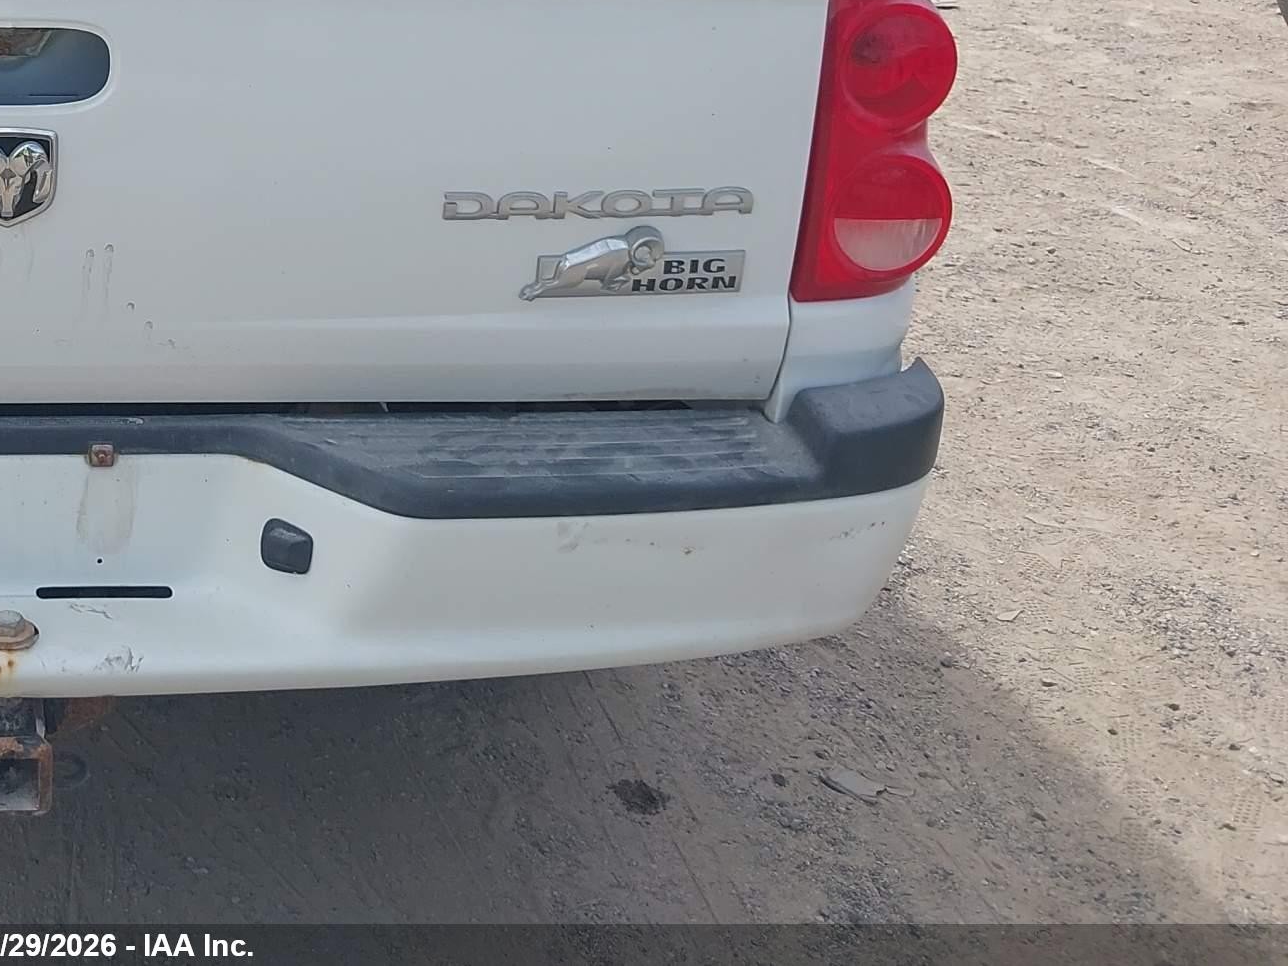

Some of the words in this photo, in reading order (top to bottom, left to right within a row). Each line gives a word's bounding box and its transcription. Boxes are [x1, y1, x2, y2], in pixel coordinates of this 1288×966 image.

[442, 186, 754, 221] DAKOTA
[663, 258, 726, 275] BIG
[631, 275, 736, 292] HORN
